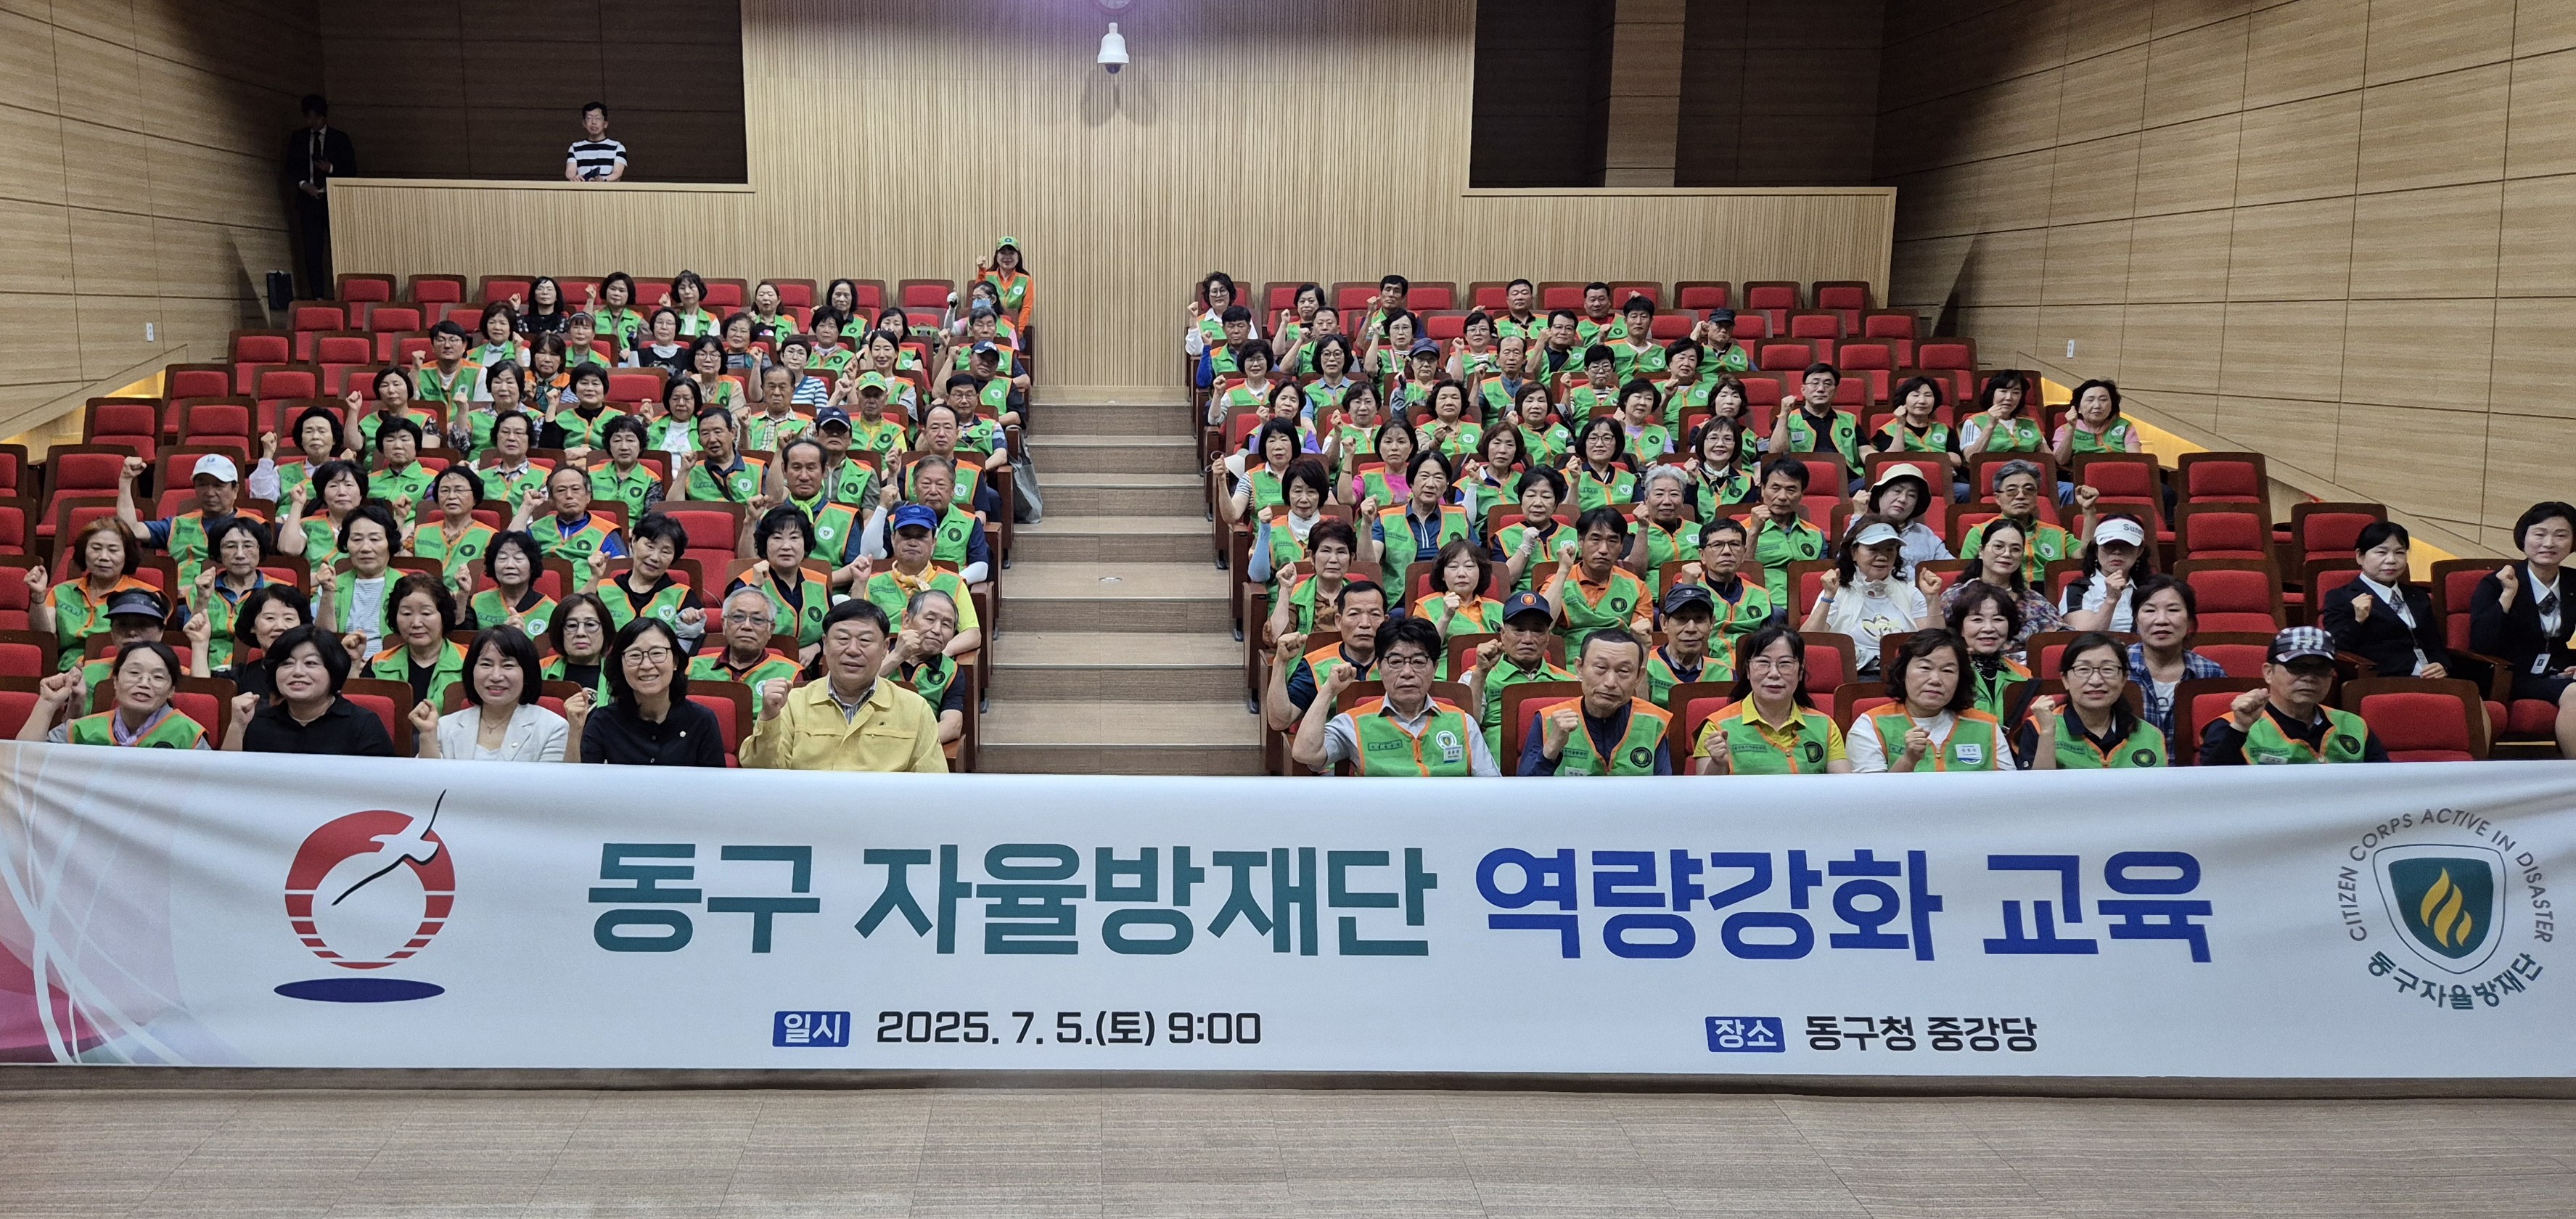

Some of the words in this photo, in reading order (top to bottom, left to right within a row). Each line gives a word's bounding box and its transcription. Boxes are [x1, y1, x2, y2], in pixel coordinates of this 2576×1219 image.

[2350, 813, 2413, 862] CORPS
[2421, 808, 2491, 837] ACTIVE
[2490, 830, 2516, 852] IN
[588, 842, 821, 953] 동구
[854, 843, 1437, 957] 자율방재단
[1475, 847, 1943, 961] 역량강화
[1983, 850, 2213, 964] 교육
[2338, 866, 2367, 942] CITIZEN
[2515, 851, 2554, 943] DISASTER
[2368, 951, 2543, 1010] 동구자율방재단
[782, 1013, 843, 1045] 일시
[877, 1011, 999, 1045] 2025.
[1012, 1011, 1043, 1045] 7.
[1057, 1010, 1155, 1046] 5.(토)
[1168, 1011, 1261, 1044] 9:00
[1713, 1019, 1779, 1049] 장소
[1805, 1015, 1916, 1051] 동구청
[1927, 1017, 2038, 1052] 중강당
